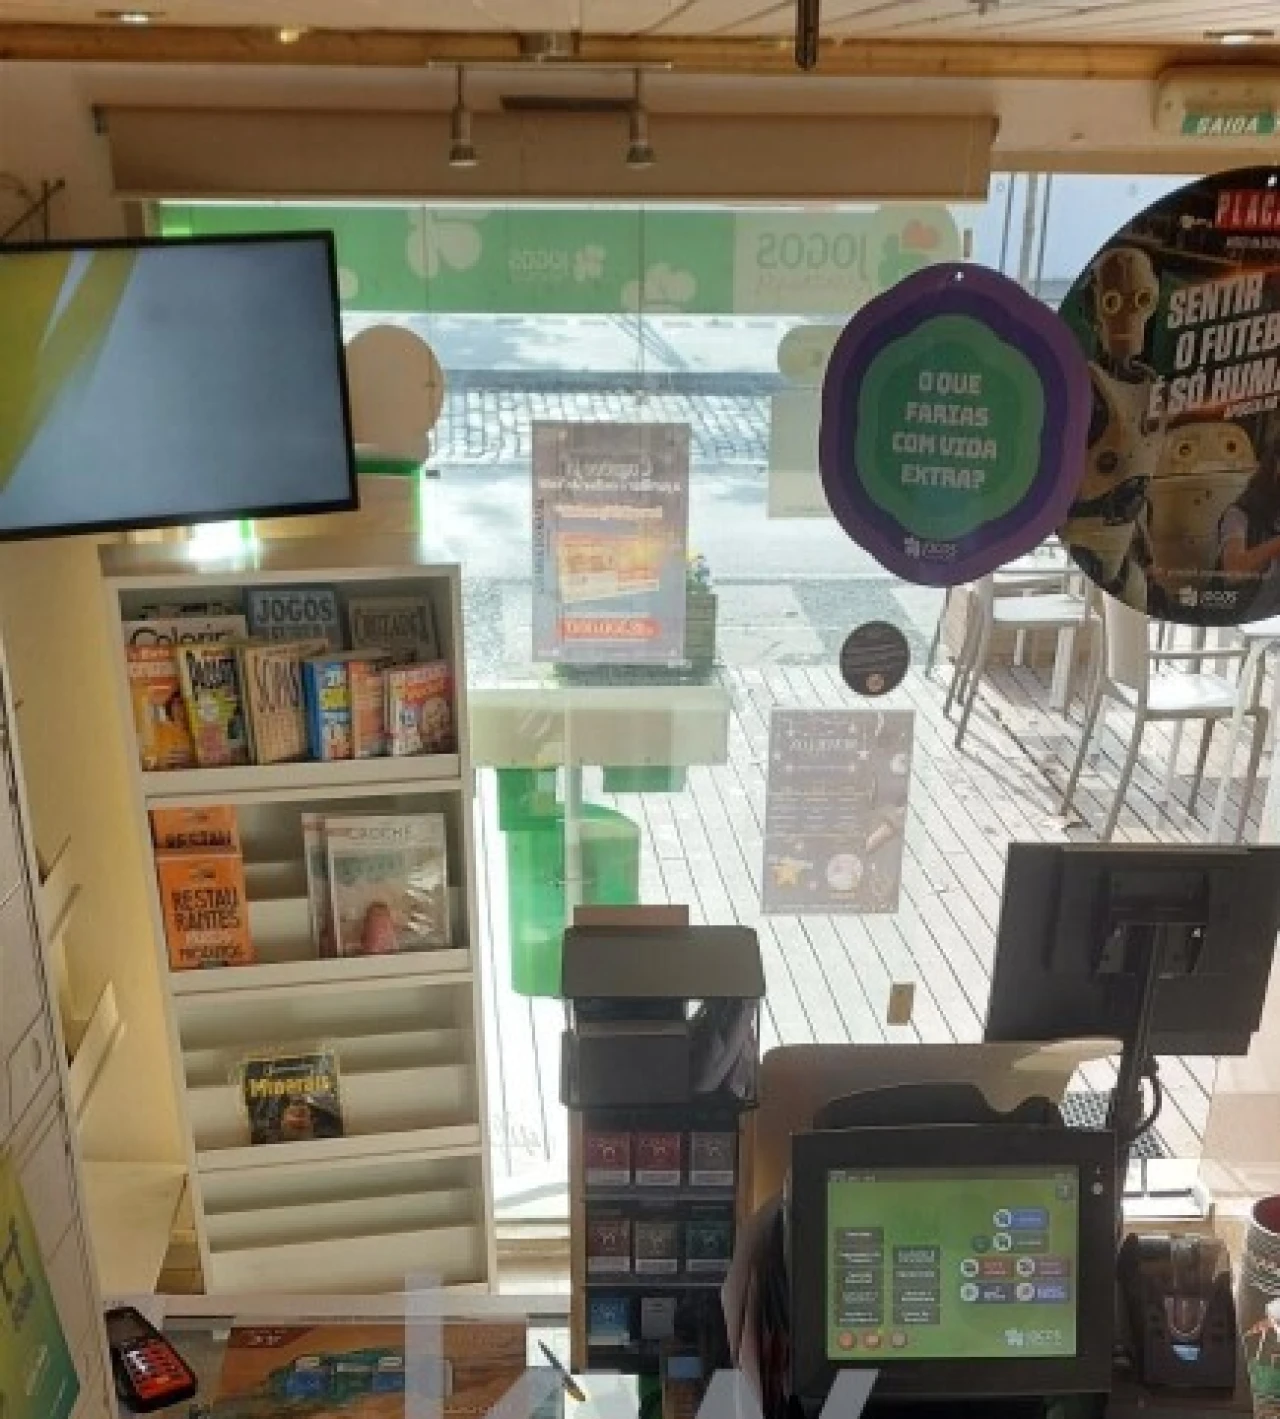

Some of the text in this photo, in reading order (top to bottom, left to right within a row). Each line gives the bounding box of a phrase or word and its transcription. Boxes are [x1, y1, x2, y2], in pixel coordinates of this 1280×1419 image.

[1168, 272, 1264, 329] SENTIR
[1174, 331, 1195, 370] O
[919, 372, 982, 395] O QUE
[905, 403, 988, 427] FARIAS
[892, 432, 997, 460] COM VIDA
[901, 466, 986, 490] EXTRA?
[256, 598, 334, 623] JOGOS
[171, 885, 239, 911] RESTAU
[174, 906, 240, 933] RANTES
[249, 1074, 331, 1098] Minerais
